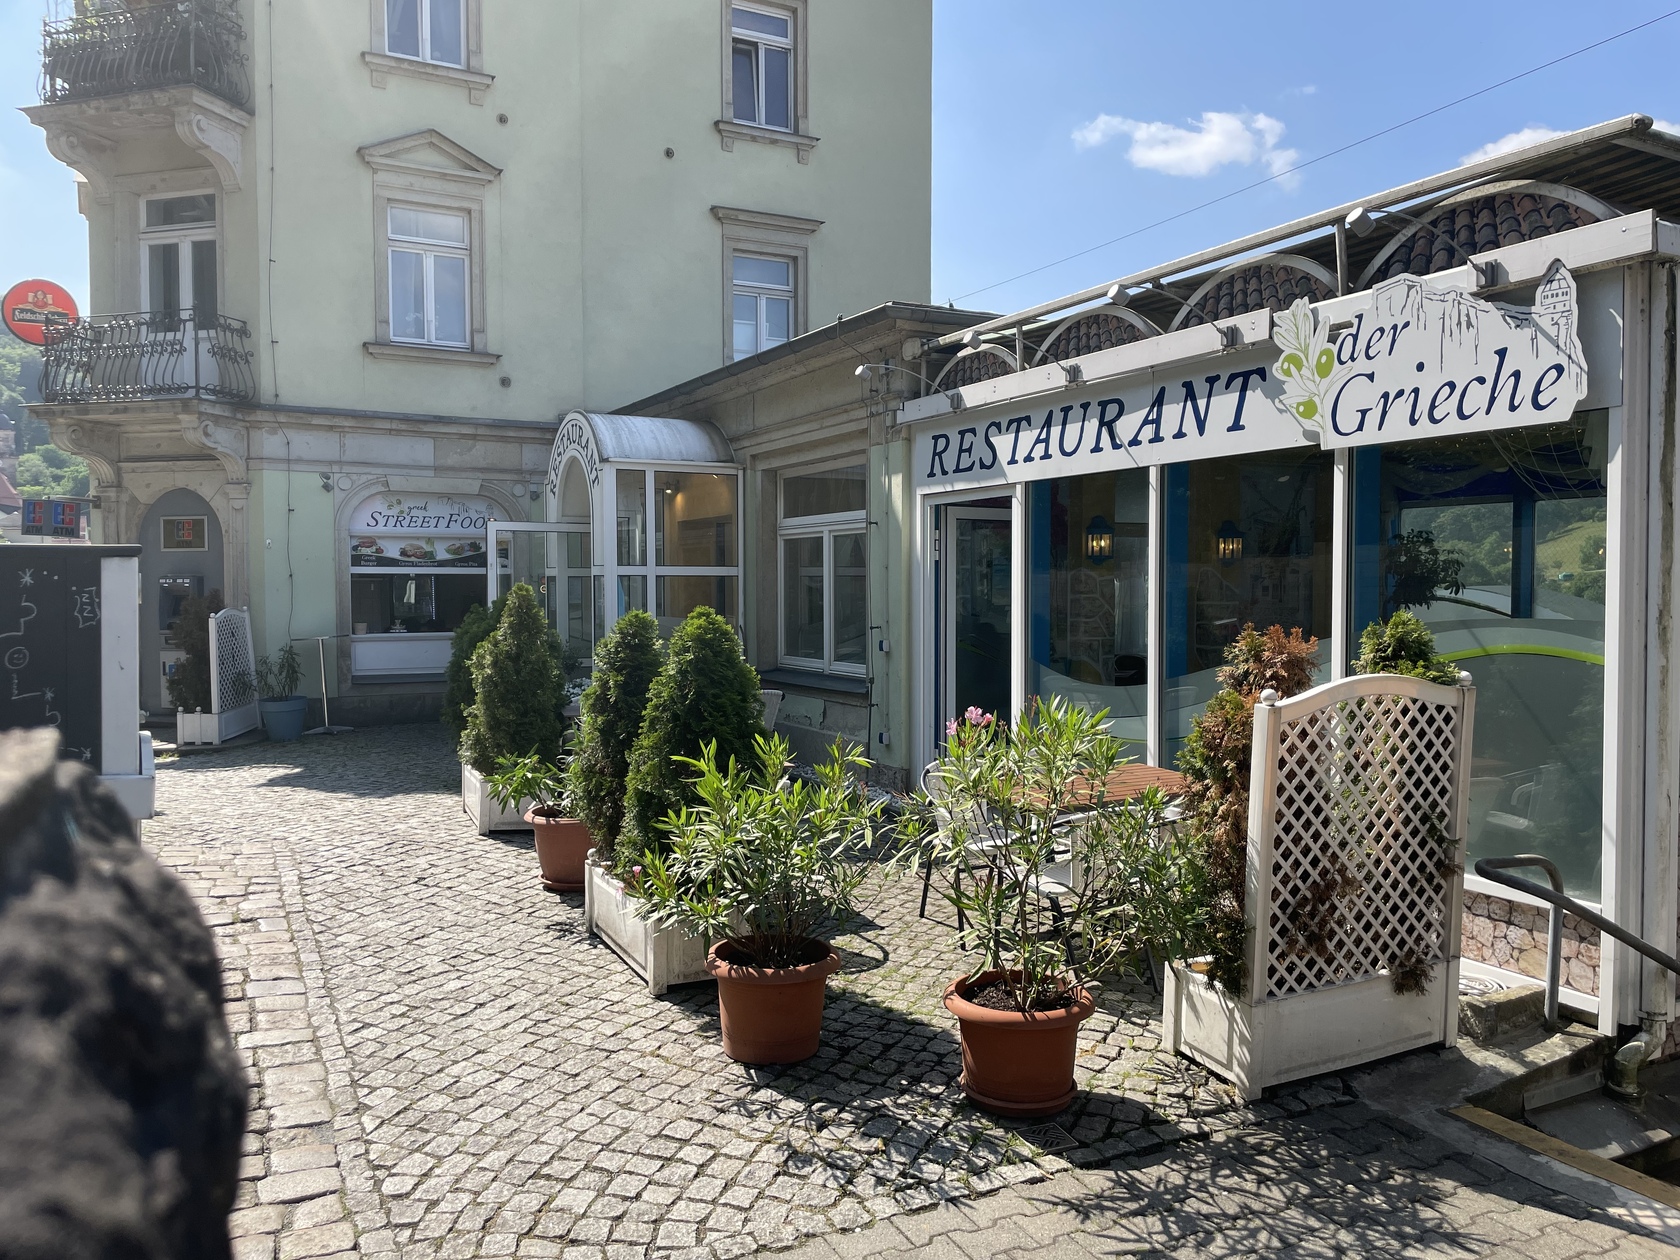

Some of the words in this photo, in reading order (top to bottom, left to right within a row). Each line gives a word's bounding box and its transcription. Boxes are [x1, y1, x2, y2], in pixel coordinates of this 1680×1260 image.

[1337, 312, 1410, 366] der
[1330, 348, 1565, 438] Grieche
[926, 366, 1267, 479] RESTAURANT
[549, 423, 600, 499] RESTAURANT
[25, 526, 43, 534] ATM
[52, 527, 75, 536] ATM
[406, 501, 429, 516] greek
